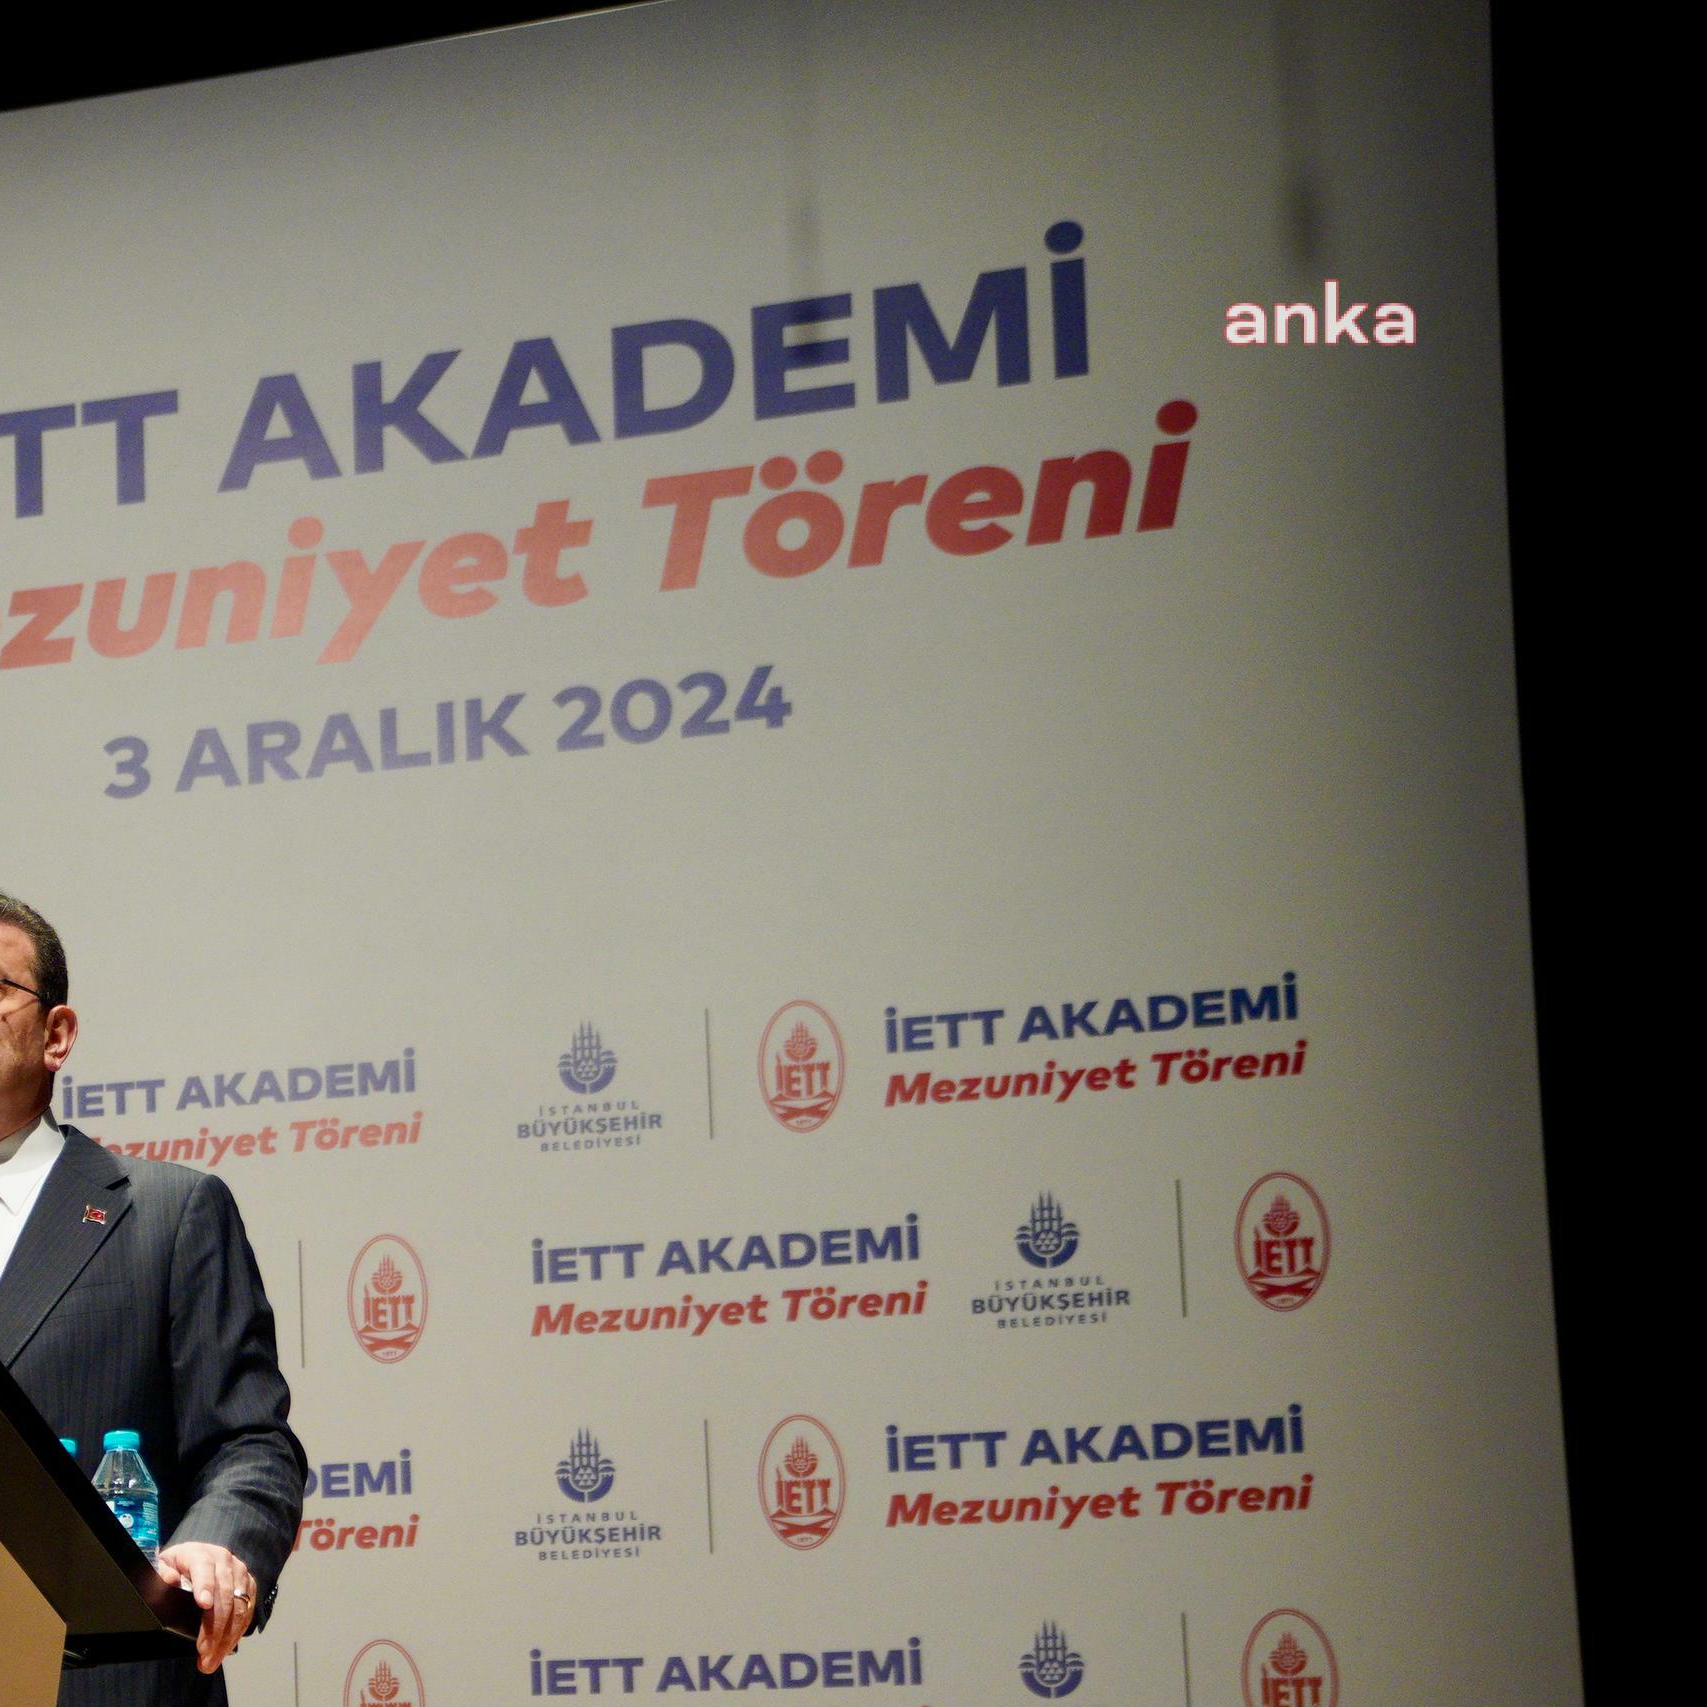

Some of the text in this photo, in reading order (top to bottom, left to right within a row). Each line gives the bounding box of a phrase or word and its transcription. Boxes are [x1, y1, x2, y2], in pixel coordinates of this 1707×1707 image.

[226, 219, 1089, 487] AKADEMİ
[639, 399, 1199, 593] Töreni
[104, 665, 792, 799] 3 ARALIK 2024
[886, 971, 1298, 1053] İETT AKADEMİ
[63, 1047, 415, 1119] İETT AKADEMİ
[886, 1040, 1308, 1106] Mezuniyet Töreni
[91, 1110, 424, 1168] zuniyet Töreni
[533, 1213, 919, 1284] İETT AKADEMİ
[532, 1280, 928, 1336] Mezuniyet Töreni
[971, 1287, 1131, 1314] BÜYÜKŞEHİR
[995, 1275, 1104, 1291] İSTANBUL
[998, 1312, 1107, 1328] BELEDİYESİ
[886, 1404, 1304, 1472] İETT AKADEMİ
[537, 1511, 638, 1525] İSTANBUL
[885, 1474, 1314, 1531] Mezuniyet Töreni
[515, 1523, 662, 1546] BÜYÜKŞEHİR
[538, 1546, 640, 1561] BELEDİYESİ
[531, 1637, 922, 1695] İETT AKADEMİ
